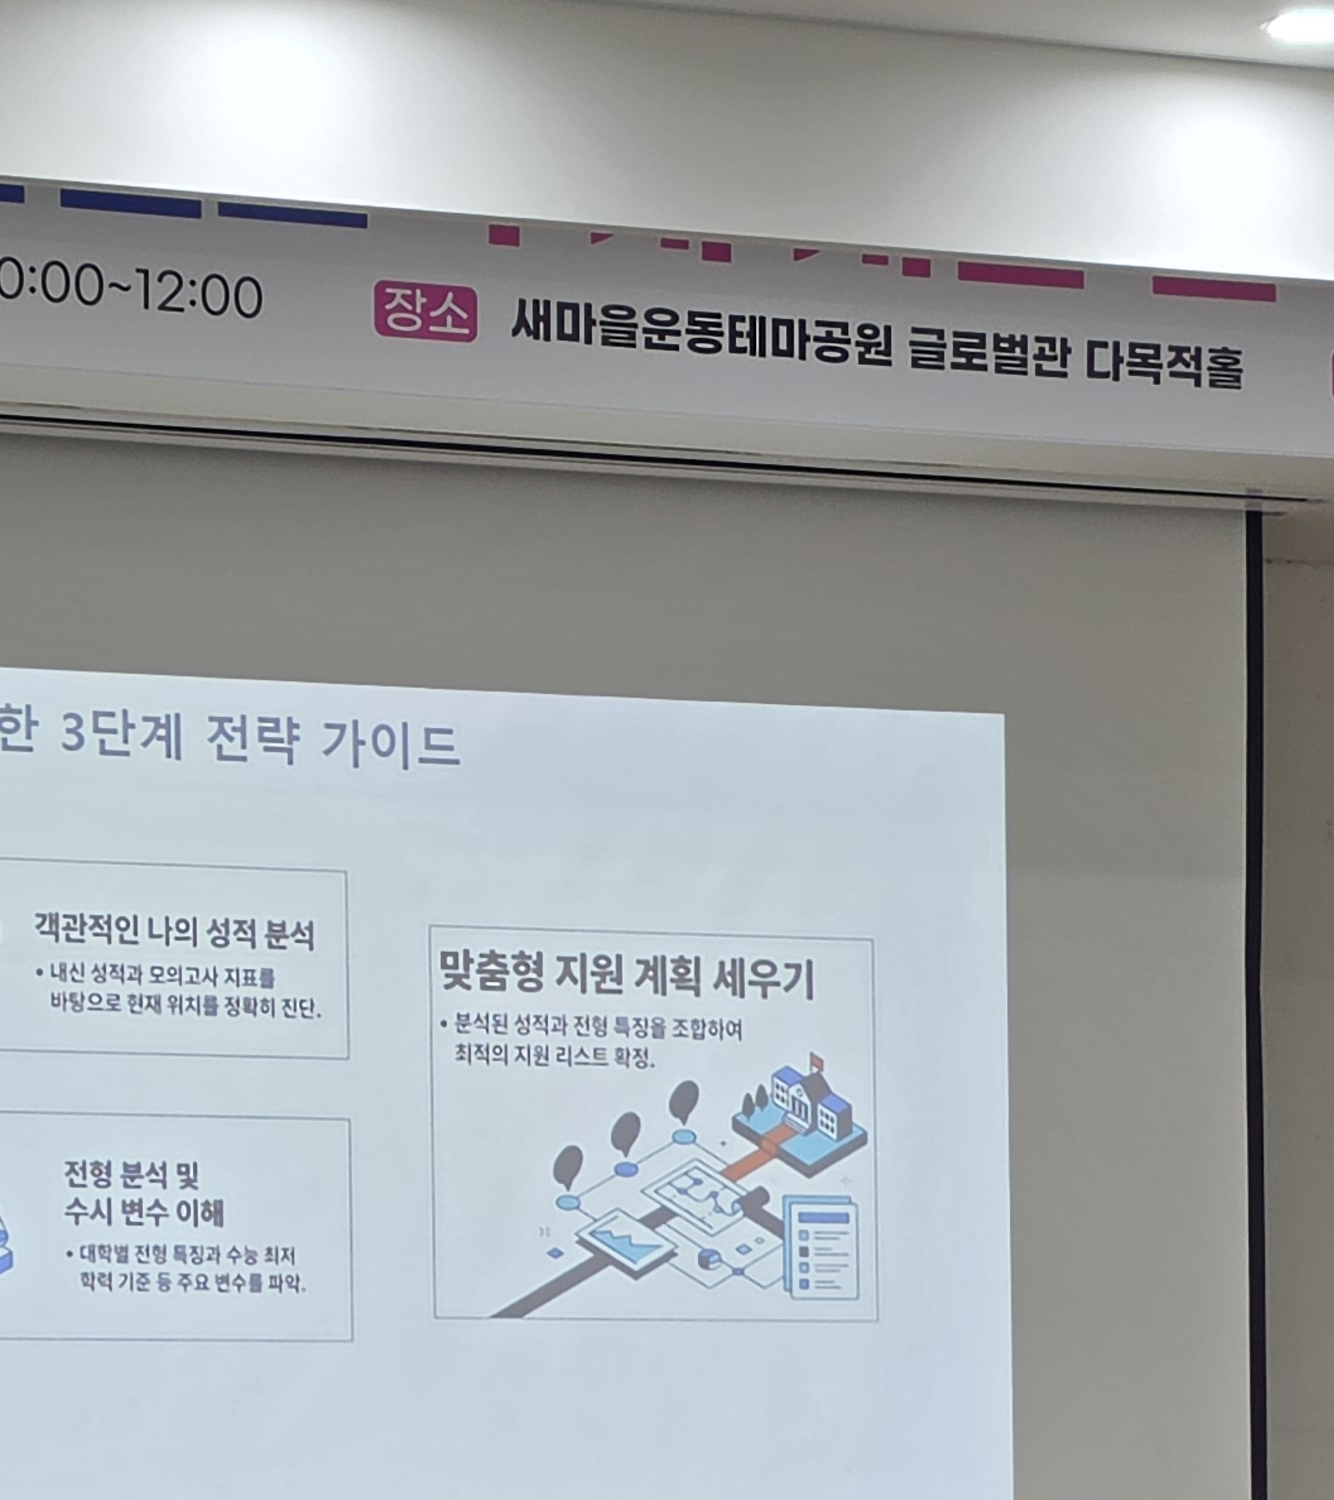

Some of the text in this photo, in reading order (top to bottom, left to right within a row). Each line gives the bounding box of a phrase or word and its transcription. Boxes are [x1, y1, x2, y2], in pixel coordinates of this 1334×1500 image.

[384, 287, 1244, 391] 장소 새마을운동테마공원 글로벌관 다목적홀
[61, 708, 182, 762] 3단계
[207, 713, 301, 766] 전략
[322, 718, 461, 771] 가이드
[34, 911, 315, 952] 객관적인 나의 성적 분석
[50, 961, 275, 990] 내신 성적과 모의고사 지표를
[439, 948, 814, 1001] 맞춤형 지원 계획 세우기
[50, 991, 322, 1020] 바탕으로 현재 위치를 정확히 진단.
[454, 1011, 743, 1042] 분석된 성적과 전형 특징을 조합하여
[455, 1042, 656, 1070] 최적의 지원 리스트 확정.
[64, 1159, 199, 1191] 전형 분석 및
[64, 1196, 224, 1229] 수시 변수 이해
[79, 1243, 295, 1267] 대학별 전형 특징과 수능 최저
[80, 1271, 306, 1294] 학력 기준 등 주요 변수를 파악.
